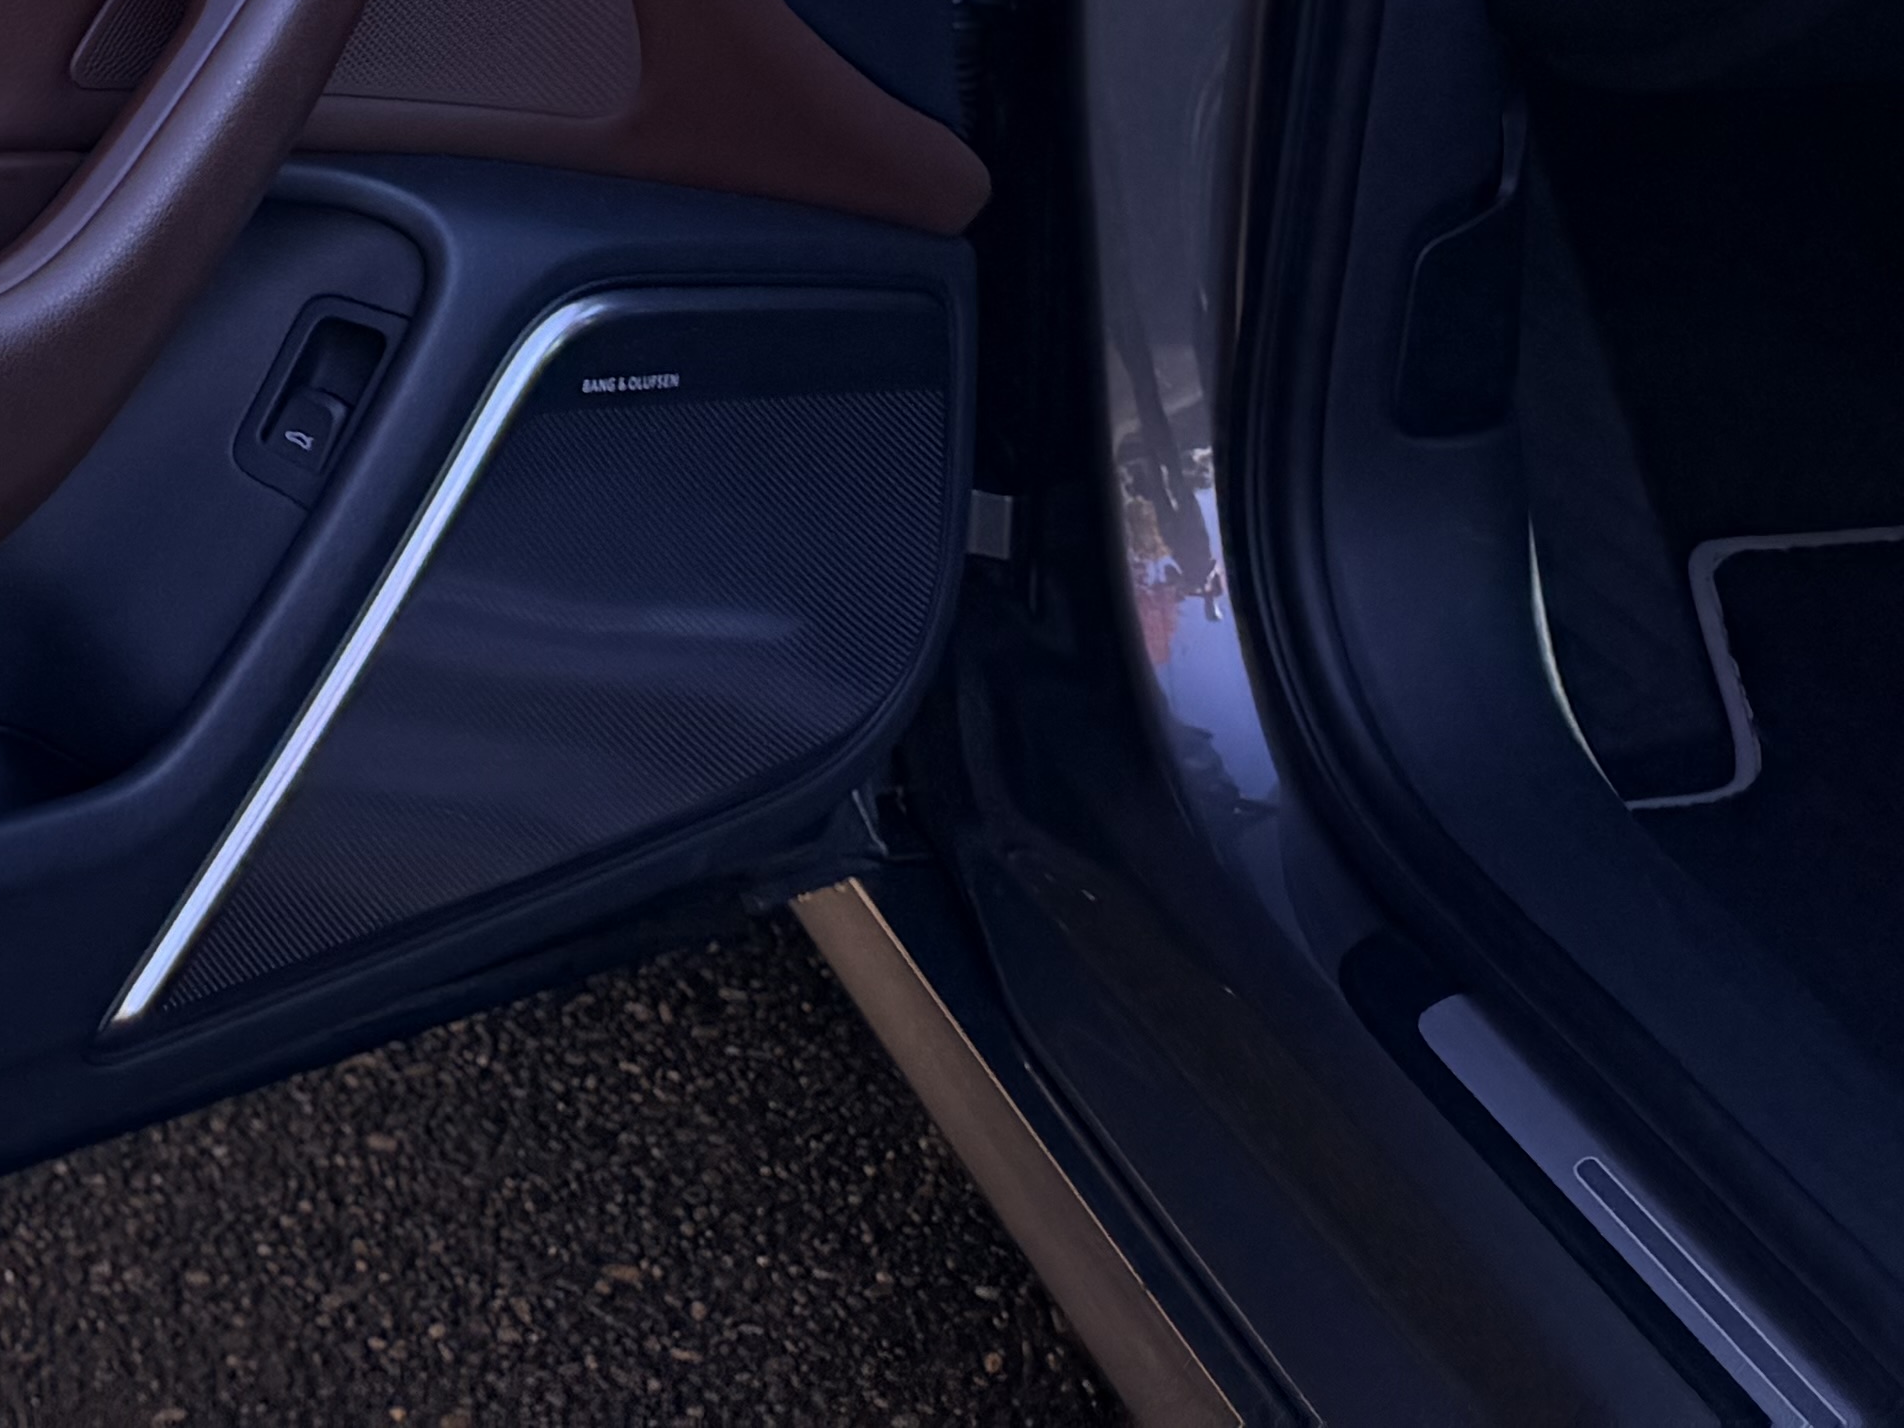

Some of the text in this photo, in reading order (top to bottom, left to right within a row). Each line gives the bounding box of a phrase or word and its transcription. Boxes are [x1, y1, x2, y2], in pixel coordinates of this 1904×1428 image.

[581, 372, 681, 394] BANG & OLUFSEN
